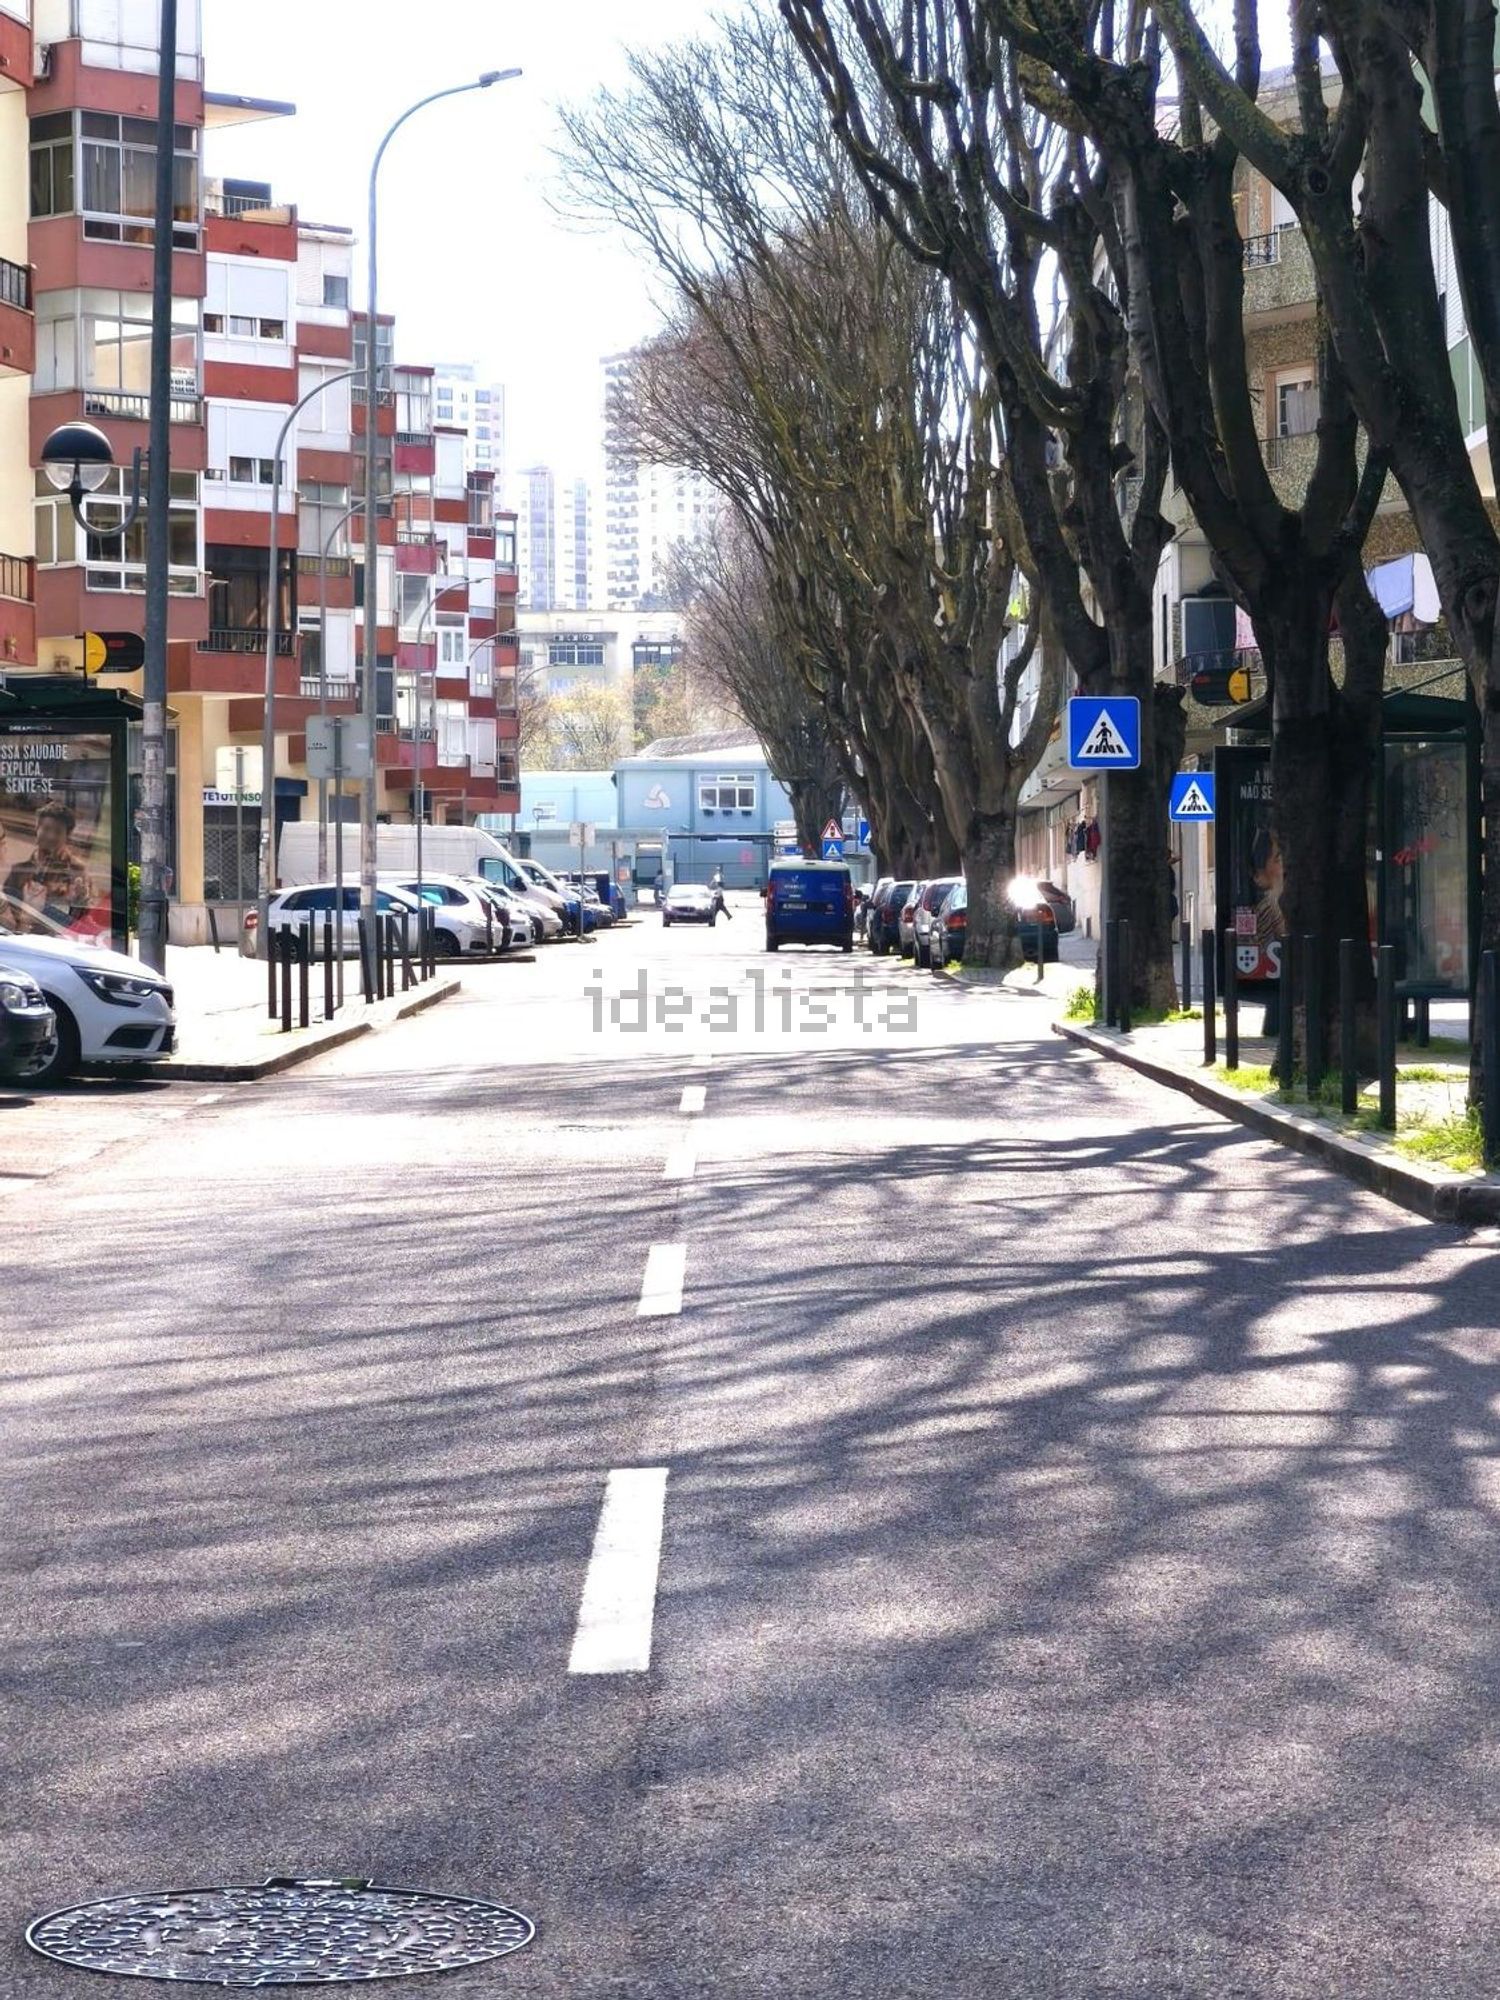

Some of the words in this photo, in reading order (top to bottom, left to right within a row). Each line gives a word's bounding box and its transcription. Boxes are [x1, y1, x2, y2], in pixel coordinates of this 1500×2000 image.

[1, 744, 20, 760] SSA
[23, 744, 68, 760] SAUDADE
[1, 761, 44, 777] EXPLICA,
[5, 777, 55, 793] SENTE-SE
[1240, 781, 1259, 800] NÃO
